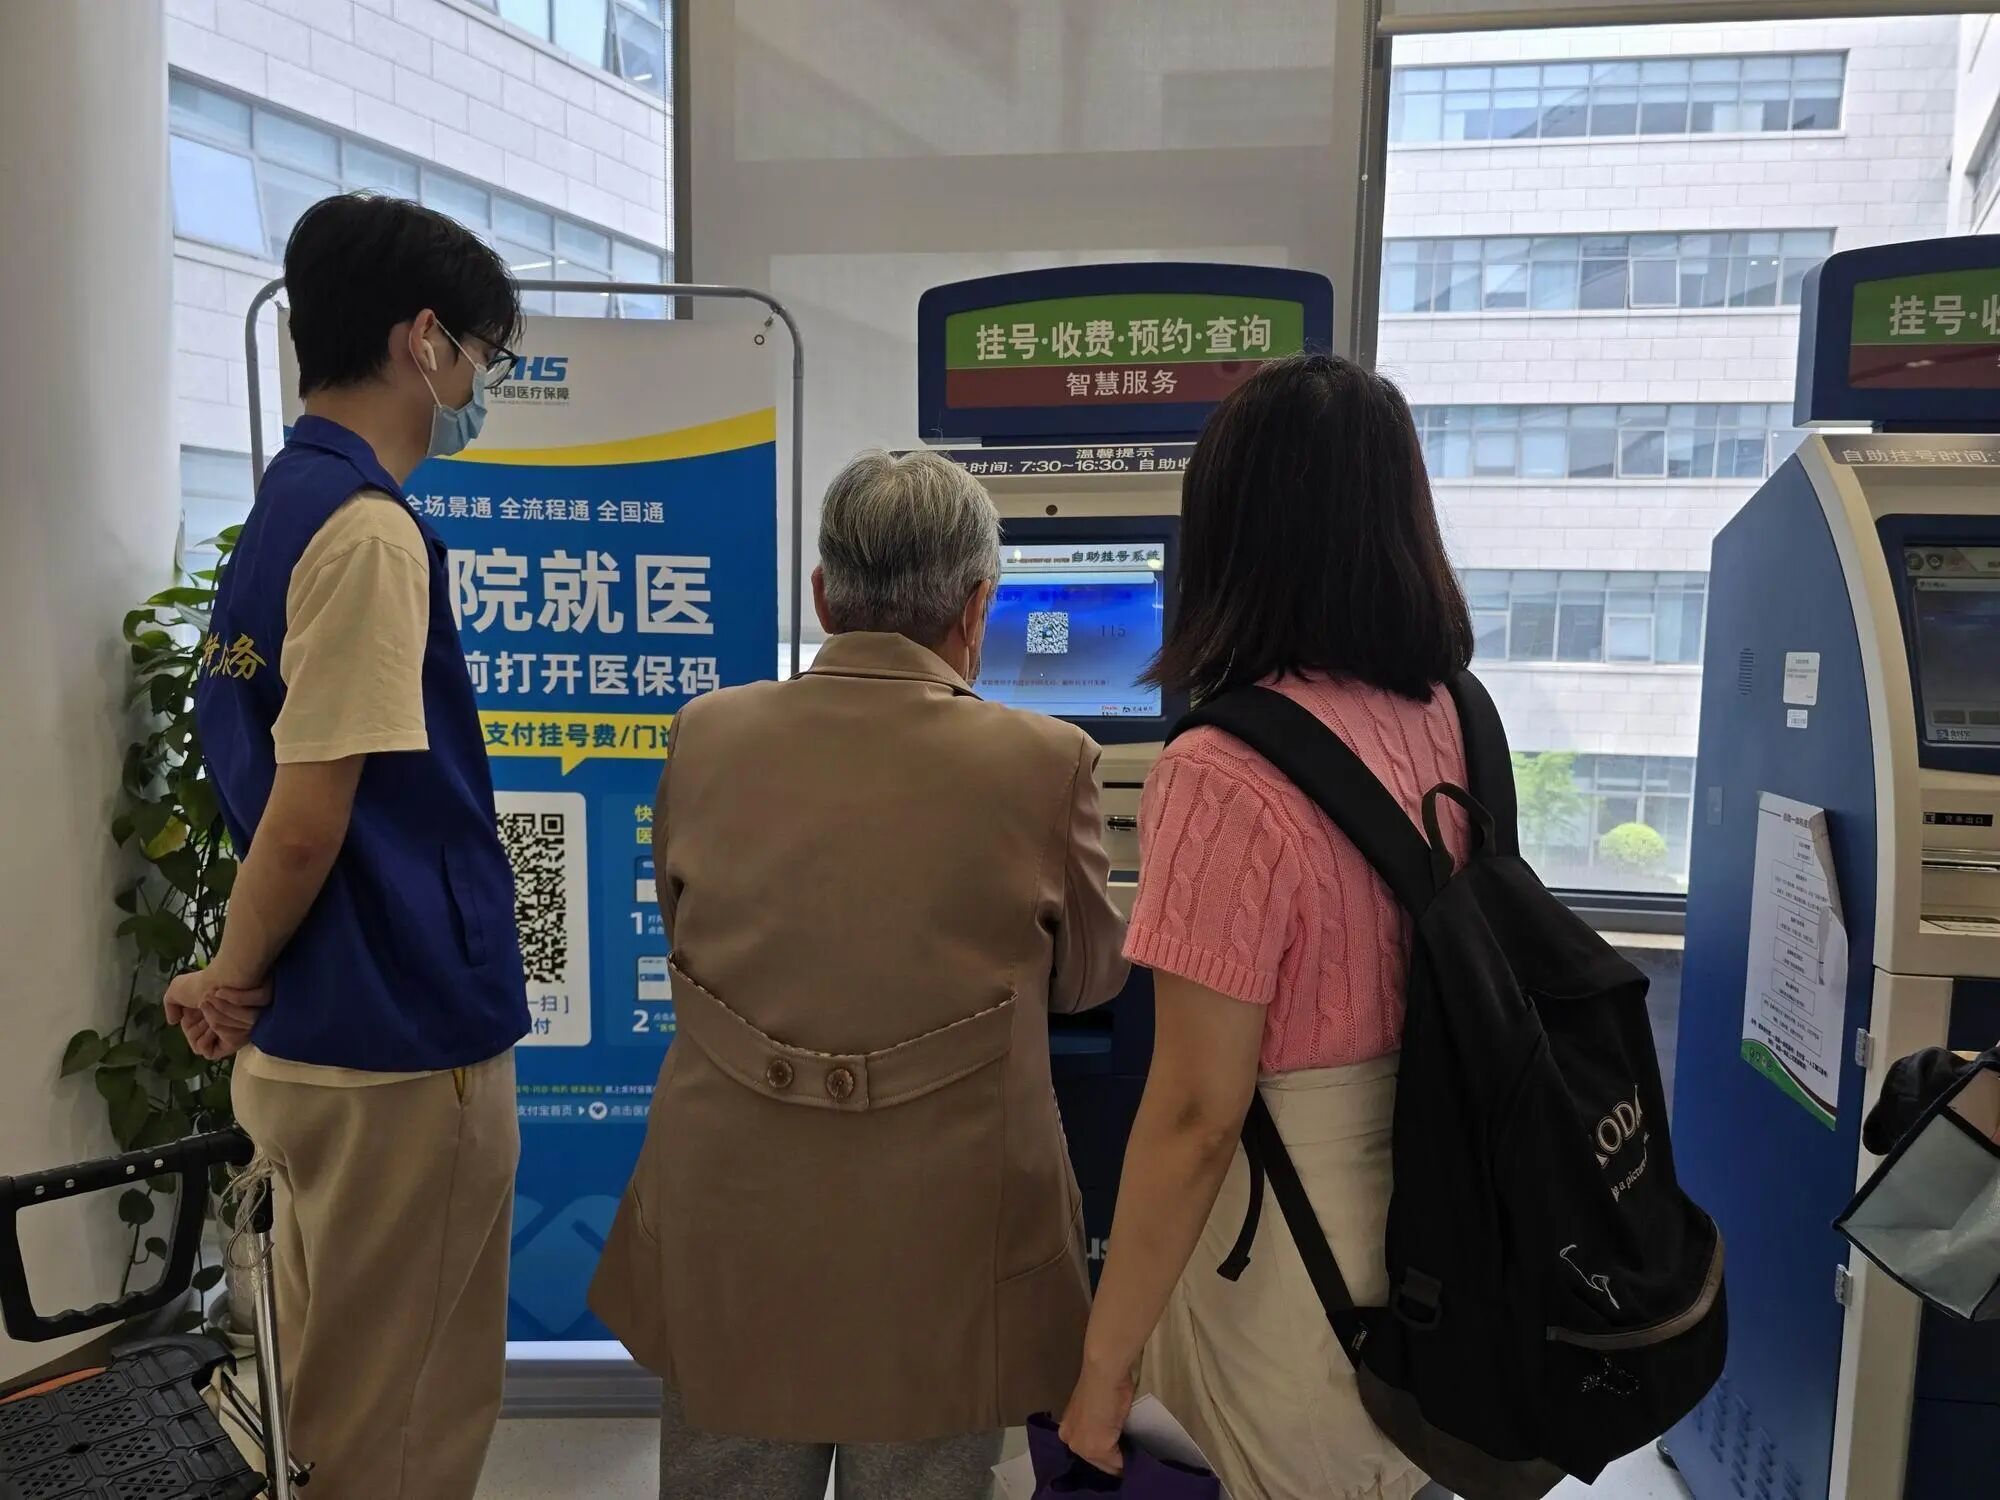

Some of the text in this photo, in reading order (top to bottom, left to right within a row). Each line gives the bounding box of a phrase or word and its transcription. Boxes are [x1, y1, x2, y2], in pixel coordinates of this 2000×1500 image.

[976, 314, 1271, 360] 挂号·收费·预约·查询
[505, 356, 569, 382] HS
[490, 386, 569, 400] 中国医疗保障
[1066, 368, 1178, 396] 智慧服务
[1076, 447, 1155, 459] 温馨提示
[406, 493, 665, 523] 全场景通 全流程通 全国通
[1072, 550, 1161, 563] 自助挂号系统
[447, 547, 714, 635] 院就医
[635, 804, 653, 823] 快
[636, 827, 653, 844] 医
[630, 911, 643, 935] 1
[529, 1017, 551, 1035] 付
[632, 1009, 650, 1033] 2
